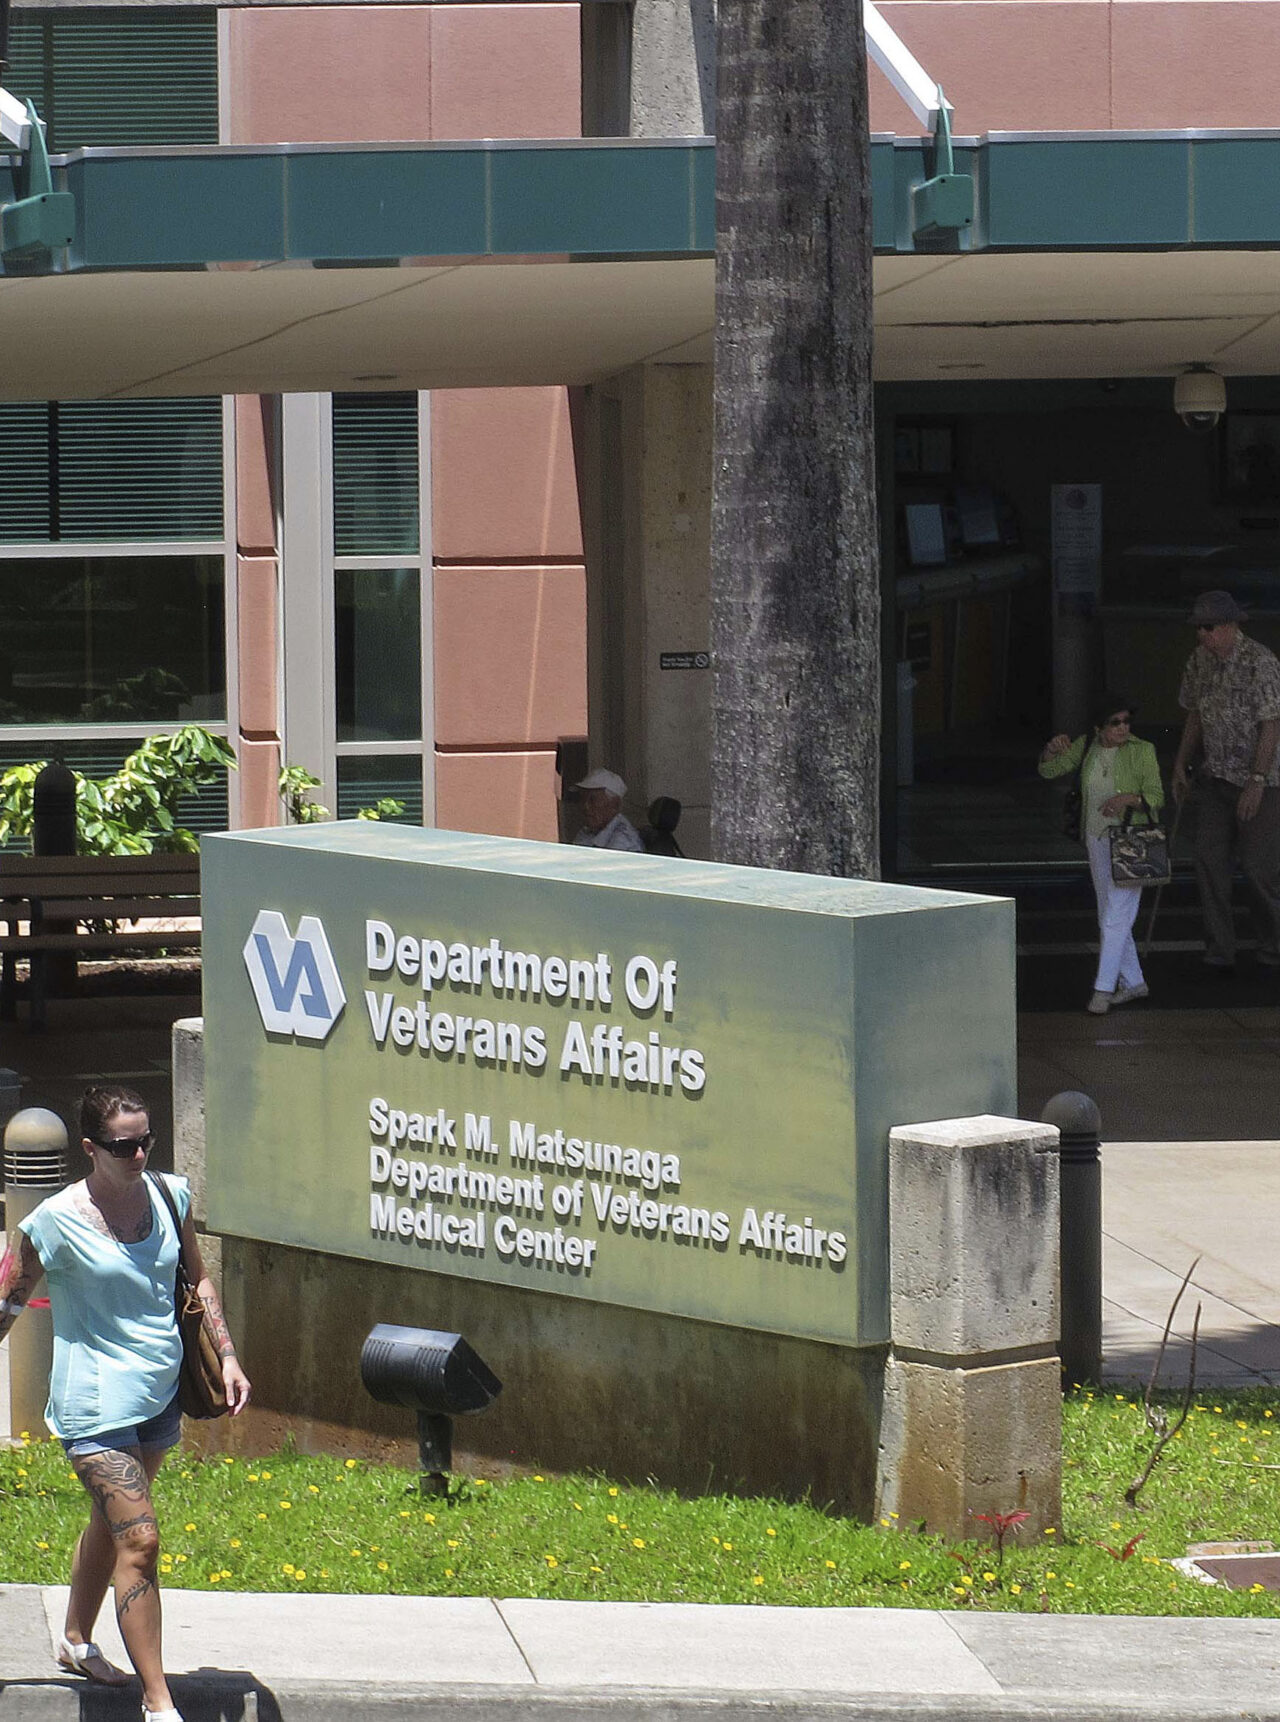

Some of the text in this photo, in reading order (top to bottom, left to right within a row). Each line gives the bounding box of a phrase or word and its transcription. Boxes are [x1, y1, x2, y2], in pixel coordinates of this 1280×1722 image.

[252, 933, 333, 1020] VA
[365, 918, 678, 1013] Department Of
[364, 990, 707, 1092] Veterans Affairs
[368, 1096, 682, 1191] Spark M. Matsunaga
[369, 1145, 848, 1263] Department of Veterans Affairs
[369, 1193, 598, 1269] Medical Center
